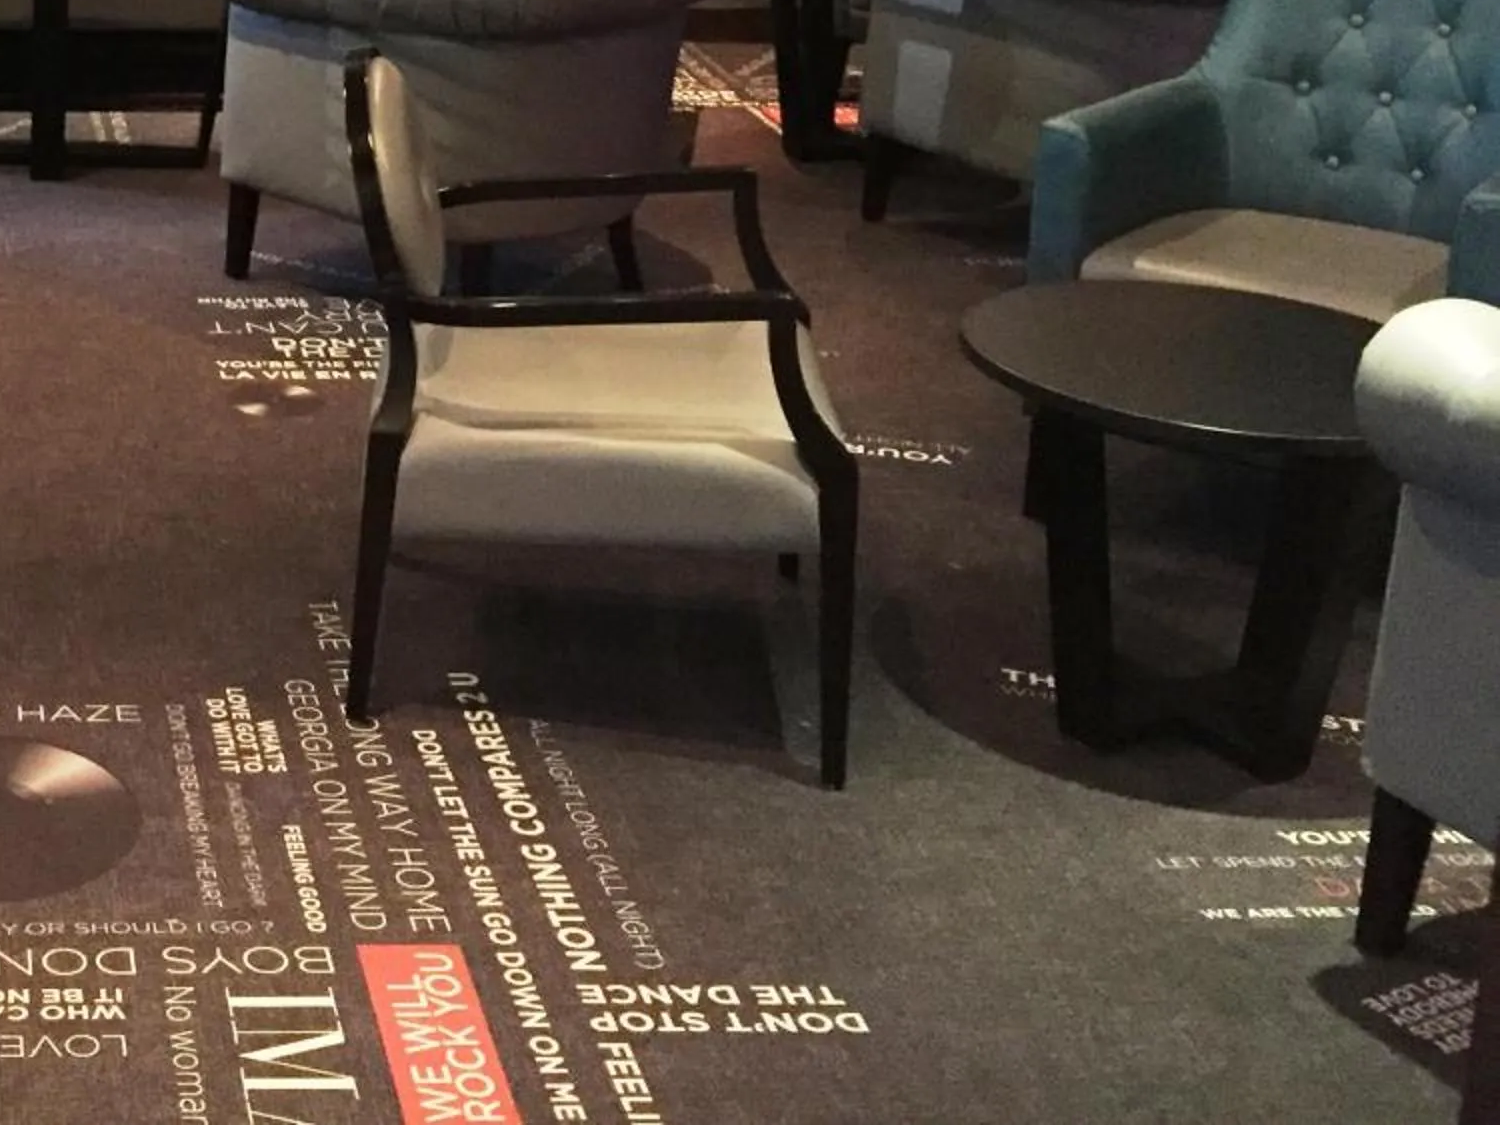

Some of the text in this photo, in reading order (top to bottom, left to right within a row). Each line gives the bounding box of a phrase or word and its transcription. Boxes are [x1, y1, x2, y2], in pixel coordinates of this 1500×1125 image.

[16, 703, 143, 724] HAZE
[204, 697, 239, 761] DO WITH
[225, 686, 265, 774] LOVE GOT TO
[283, 678, 388, 932] GEORGIA ON MY MIND
[542, 749, 586, 800] NIGHT
[564, 800, 611, 855] LONG
[448, 671, 608, 972] NOTHING COMPARES 2 U
[363, 772, 453, 933] WAY HOME
[1213, 854, 1351, 869] SPEND THE
[280, 824, 328, 934] FEELING GOOD
[22, 922, 67, 937] OR
[74, 918, 188, 937] SHOULD
[210, 920, 253, 935] GO
[411, 729, 588, 1122] DON'T LET THE SUN GO DOWN ON ME
[1200, 906, 1344, 920] WE ARE THE
[160, 945, 337, 976] BOYS
[39, 1005, 127, 1022] WHO
[42, 988, 89, 1004] BE
[94, 988, 124, 1004] IT
[163, 985, 197, 1023] No
[575, 982, 847, 1007] THE DANCE
[413, 950, 506, 1124] ROCK YOU
[588, 1010, 871, 1035] DON'T STOP
[409, 1064, 462, 1123] WE
